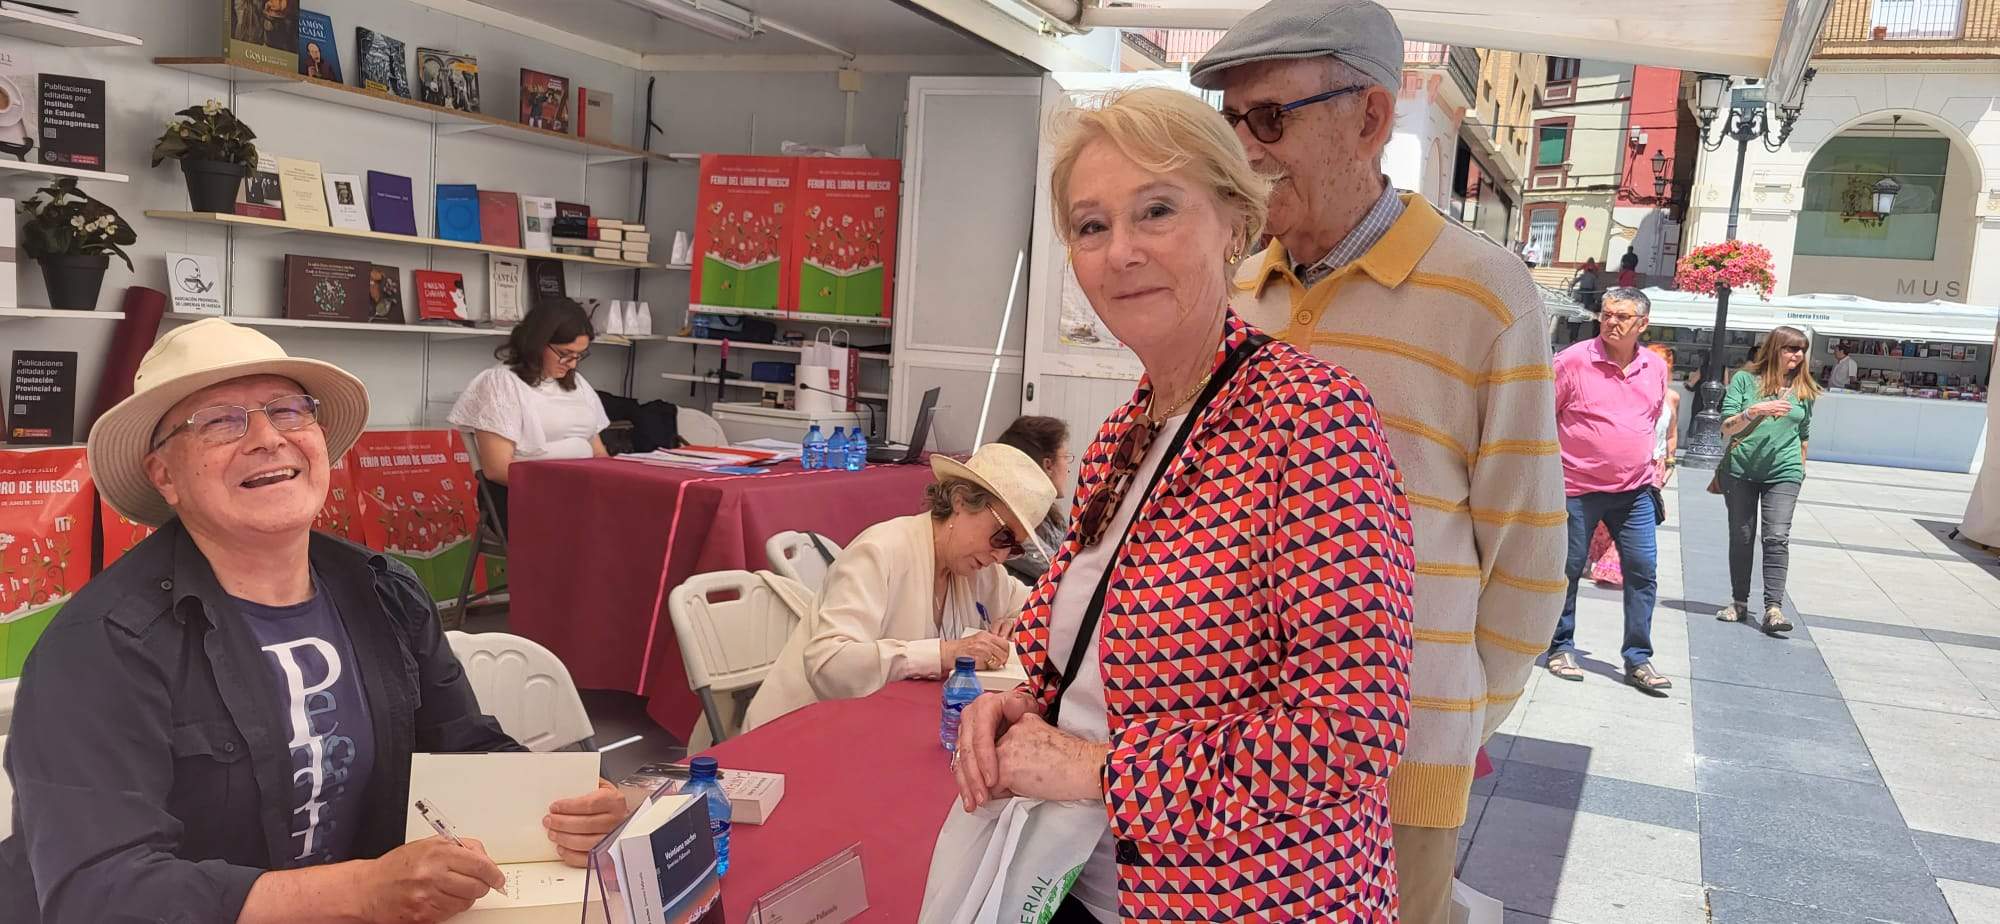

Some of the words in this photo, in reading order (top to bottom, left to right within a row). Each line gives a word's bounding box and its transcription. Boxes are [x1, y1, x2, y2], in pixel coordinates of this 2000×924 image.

[44, 82, 92, 94] Publicaciones
[44, 92, 73, 101] editadas
[74, 95, 87, 103] por
[44, 100, 74, 109] Instituto
[55, 109, 86, 119] Estudios
[43, 117, 100, 129] Altoaragoneses
[360, 455, 379, 468] FERIA
[380, 455, 393, 467] DEL
[19, 481, 32, 494] DE
[35, 479, 80, 494] HUESCA
[1021, 876, 1053, 924] ERIAL
